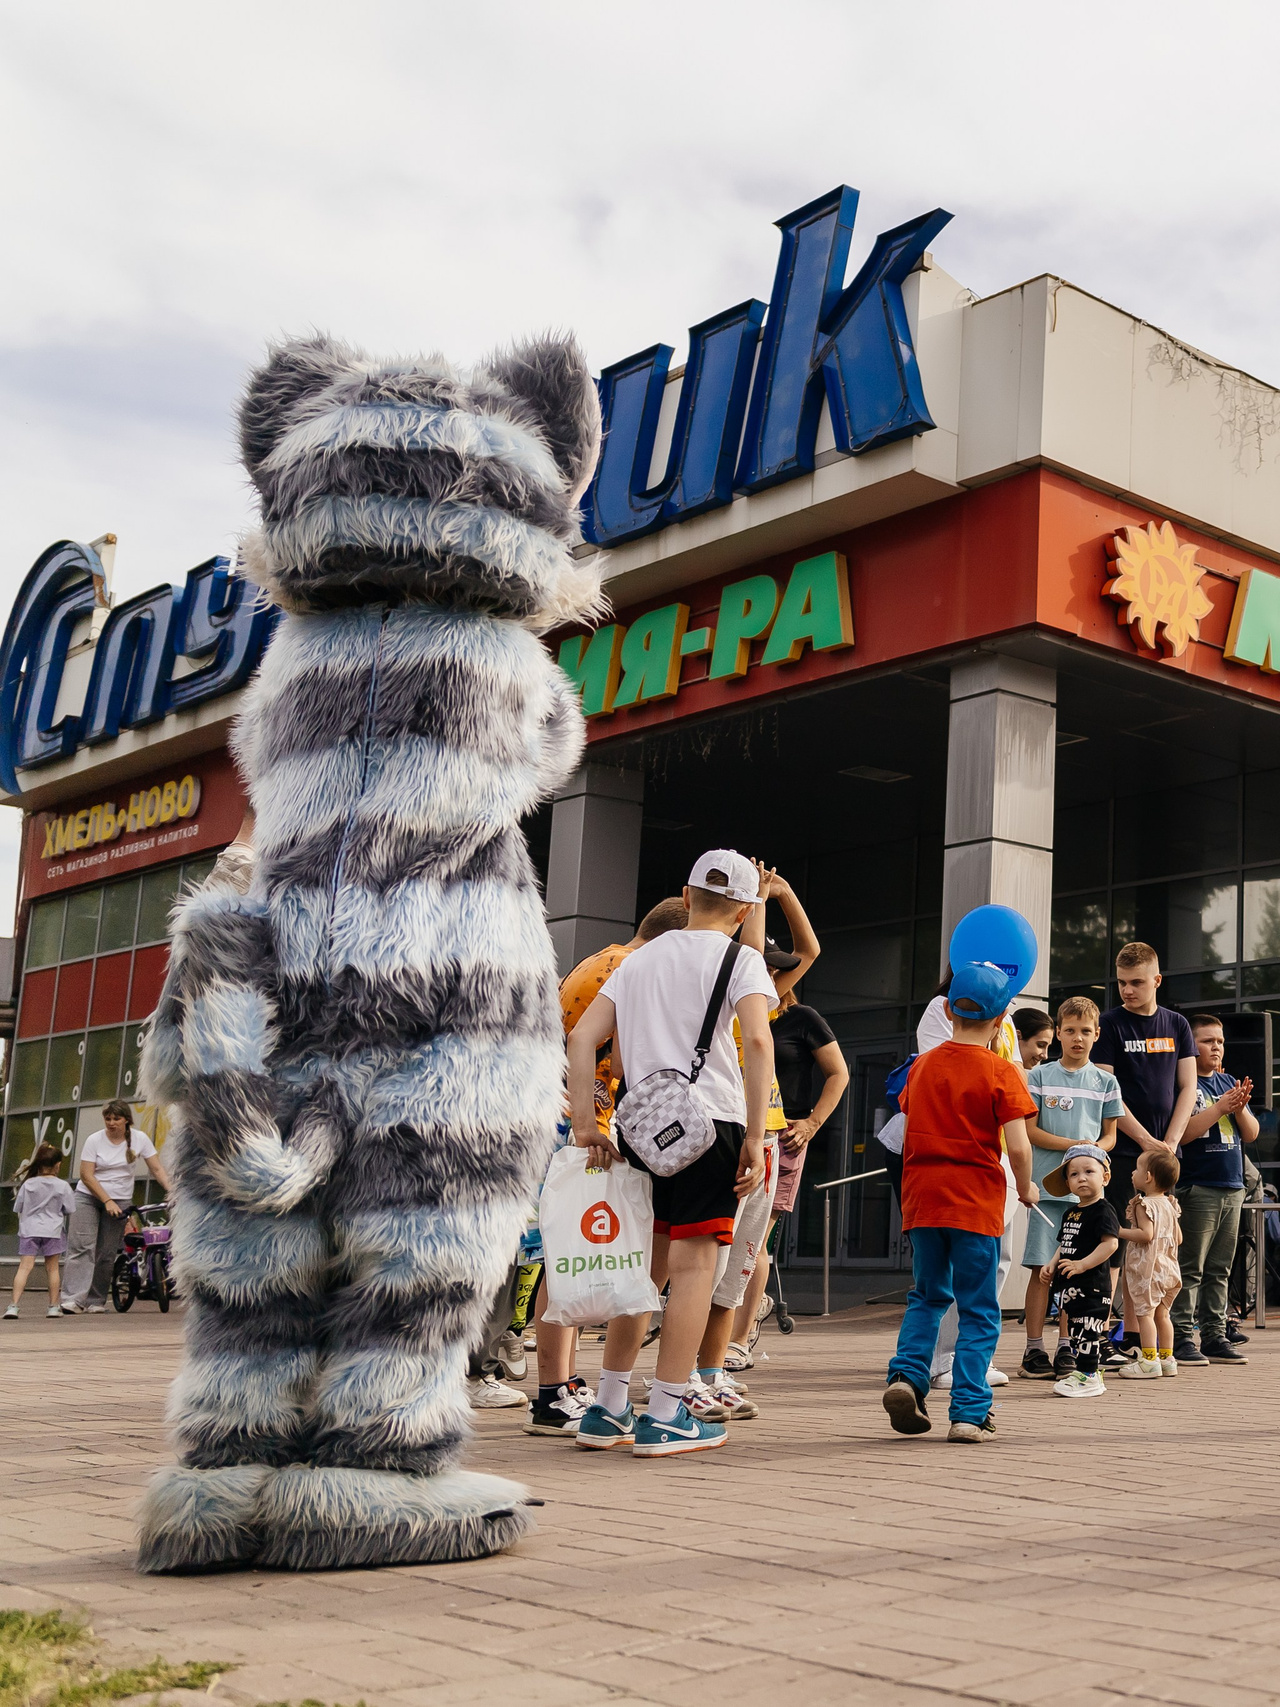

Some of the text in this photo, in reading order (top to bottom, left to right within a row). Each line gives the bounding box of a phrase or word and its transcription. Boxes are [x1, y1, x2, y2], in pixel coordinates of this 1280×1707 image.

[558, 551, 854, 718] ИЯ-РА
[47, 824, 199, 879] СЕТЬ МАГАЗИНОВ РАЗЛИВНЫХ НАПИТКОВ
[1124, 1039, 1146, 1053] JUST
[555, 1250, 644, 1277] ариант
